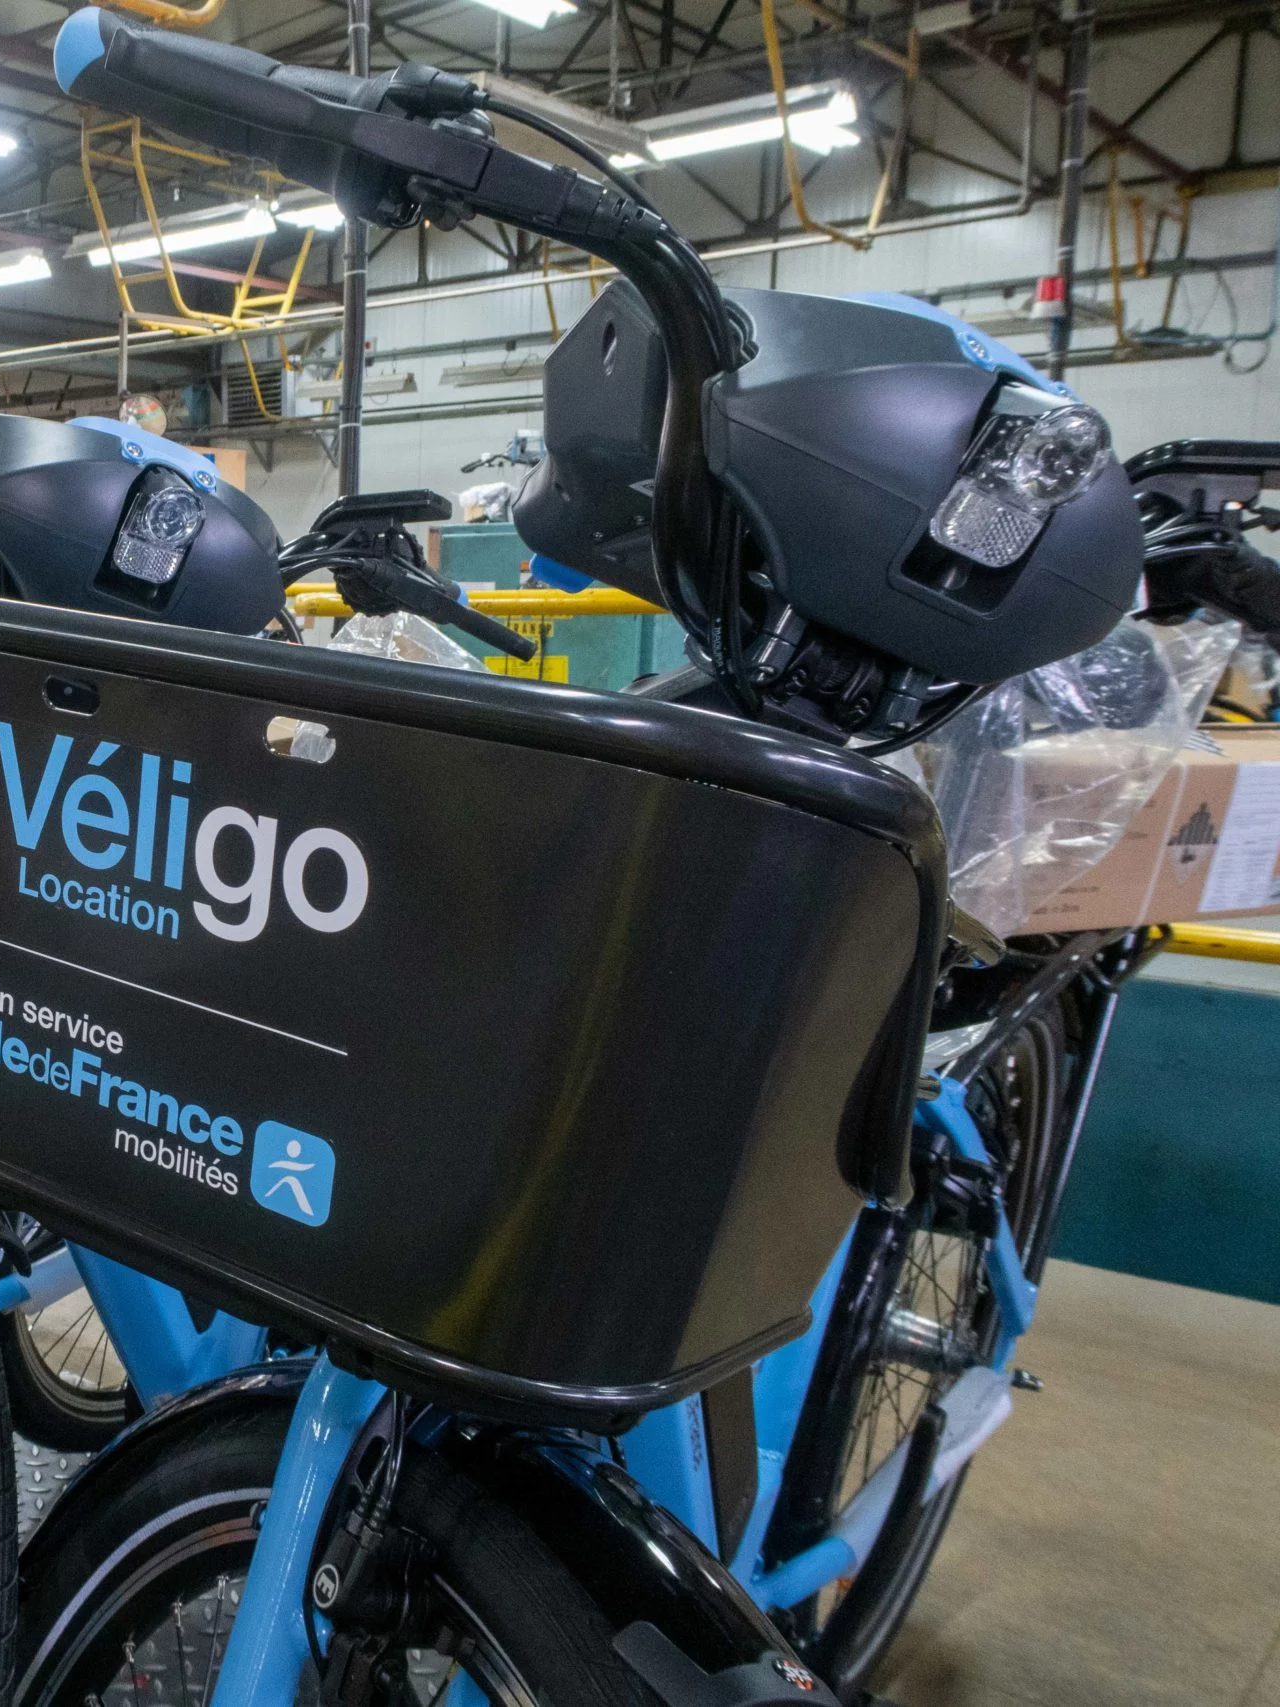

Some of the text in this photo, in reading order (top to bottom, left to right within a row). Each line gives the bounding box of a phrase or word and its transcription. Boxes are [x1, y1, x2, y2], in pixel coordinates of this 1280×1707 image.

[18, 856, 180, 940] Location
[22, 1000, 124, 1055] service
[114, 1128, 239, 1196] mobilités
